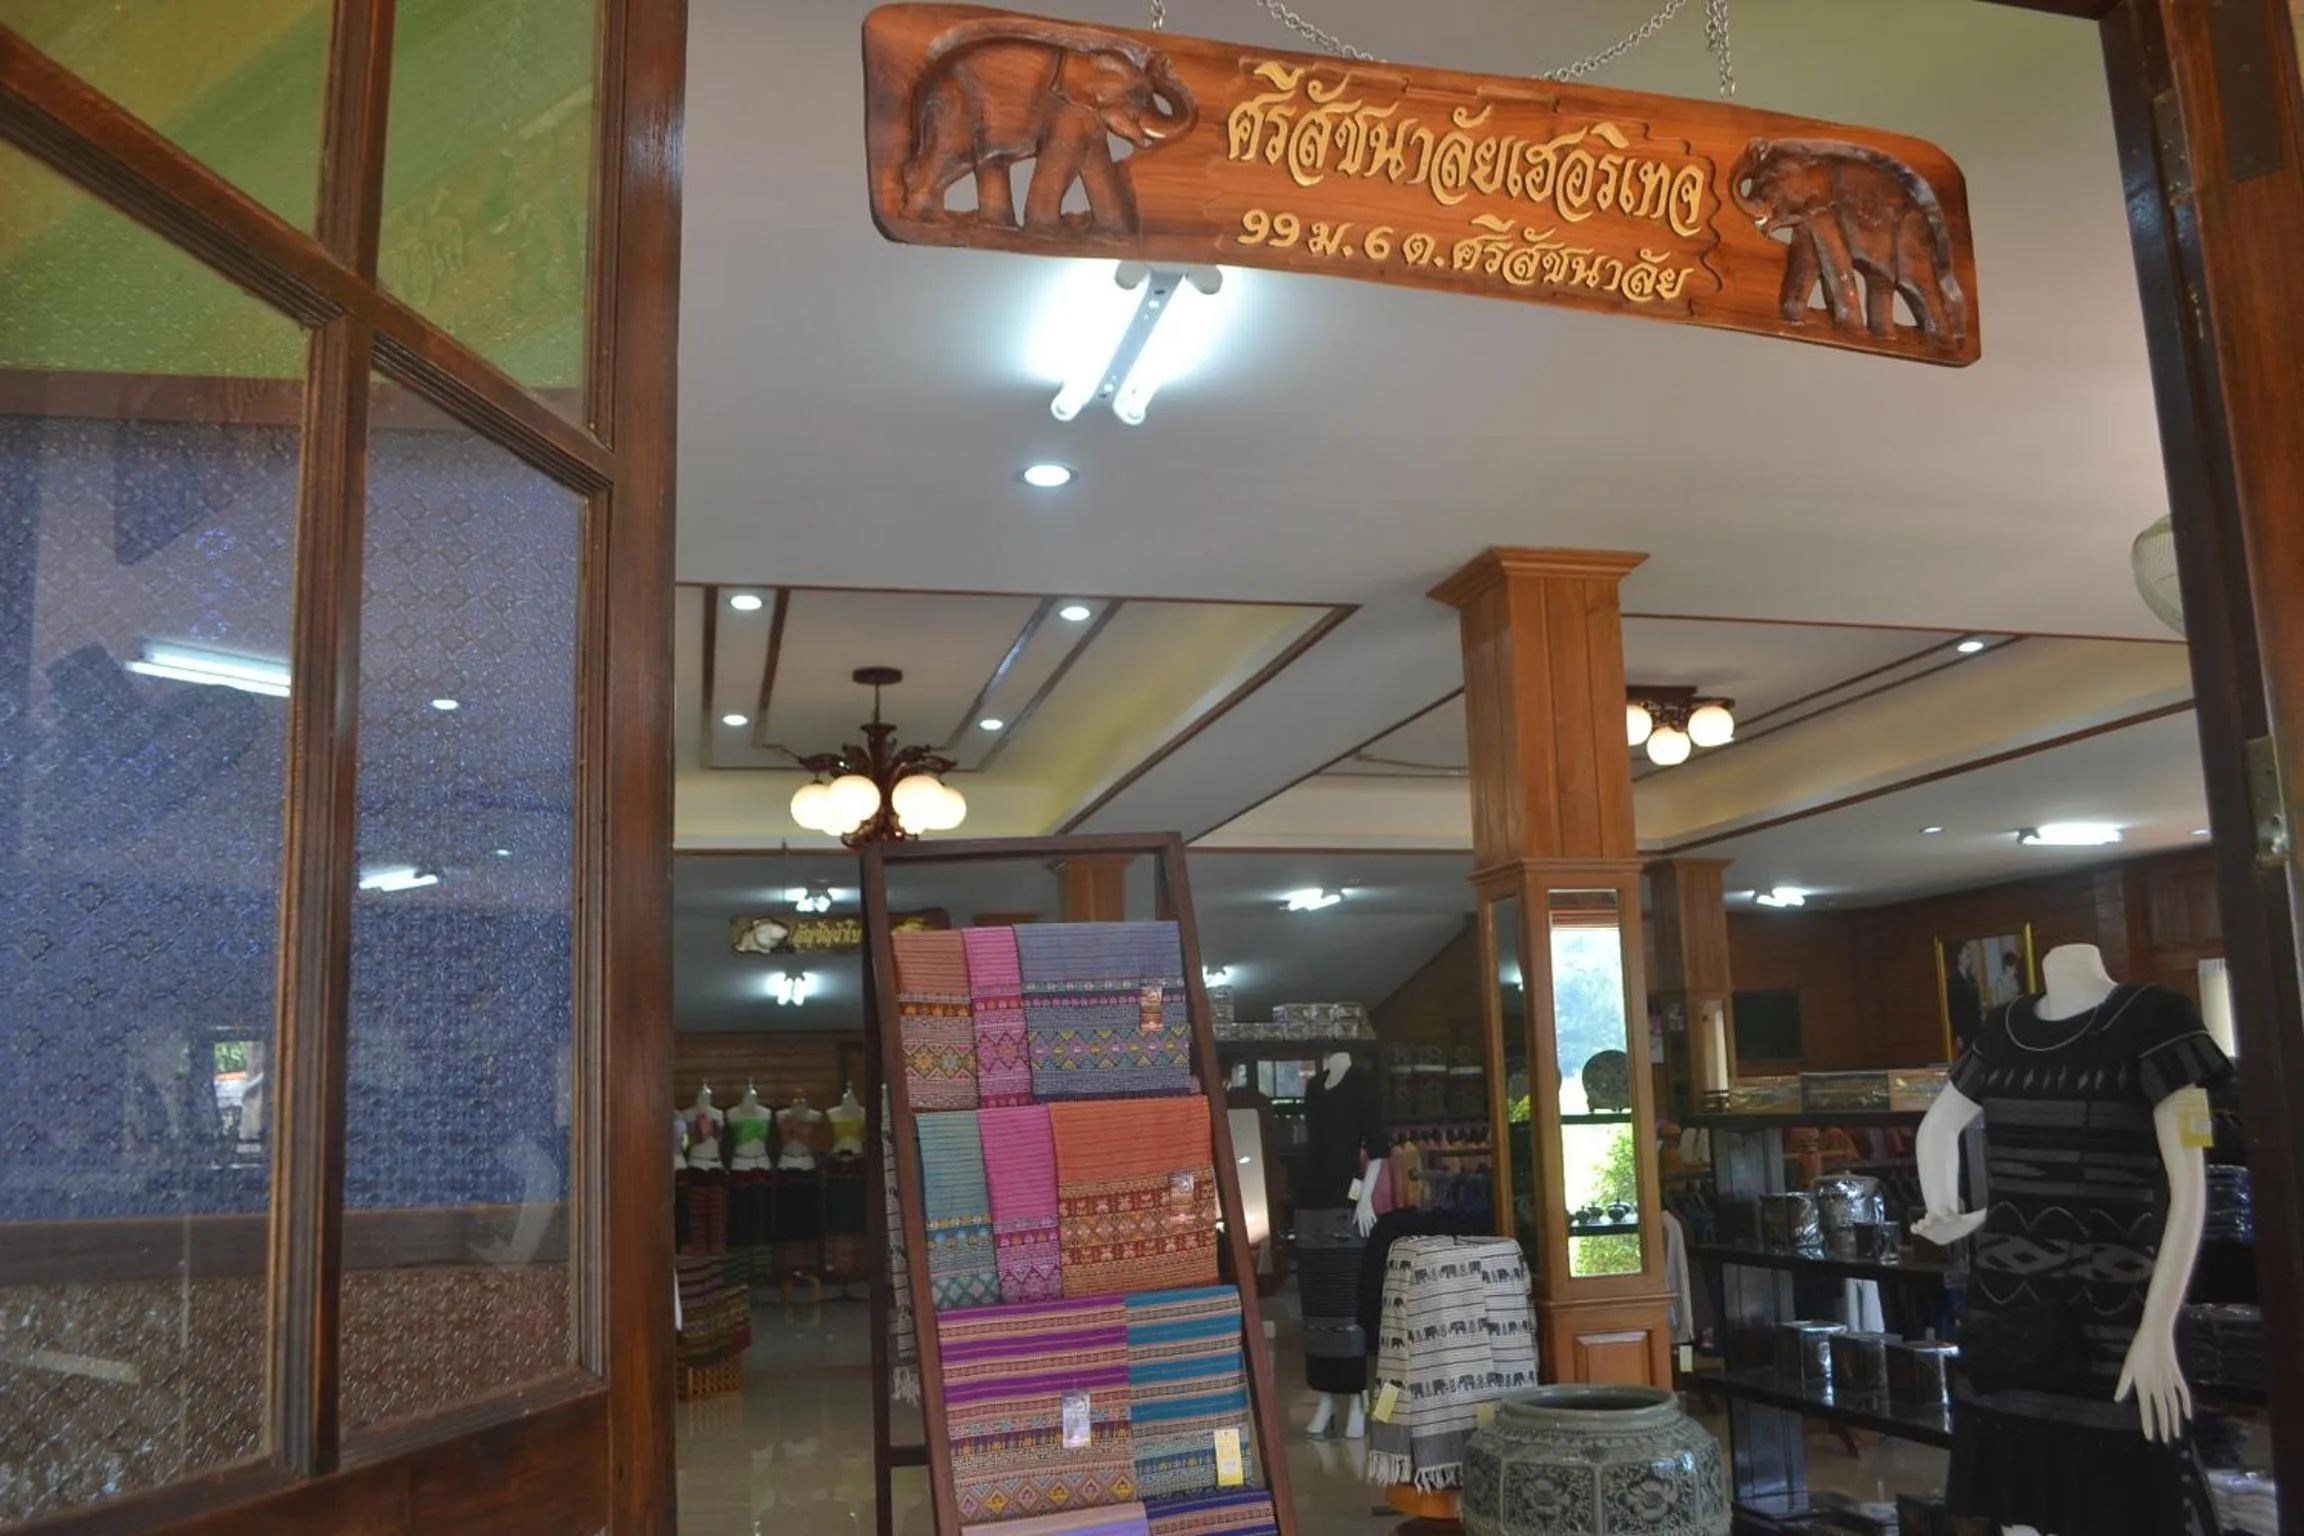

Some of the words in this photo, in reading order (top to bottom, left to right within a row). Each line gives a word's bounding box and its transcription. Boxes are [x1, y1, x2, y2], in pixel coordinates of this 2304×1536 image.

[1228, 61, 1704, 237] ศรีสัชนาลัยเฮอริเทจ
